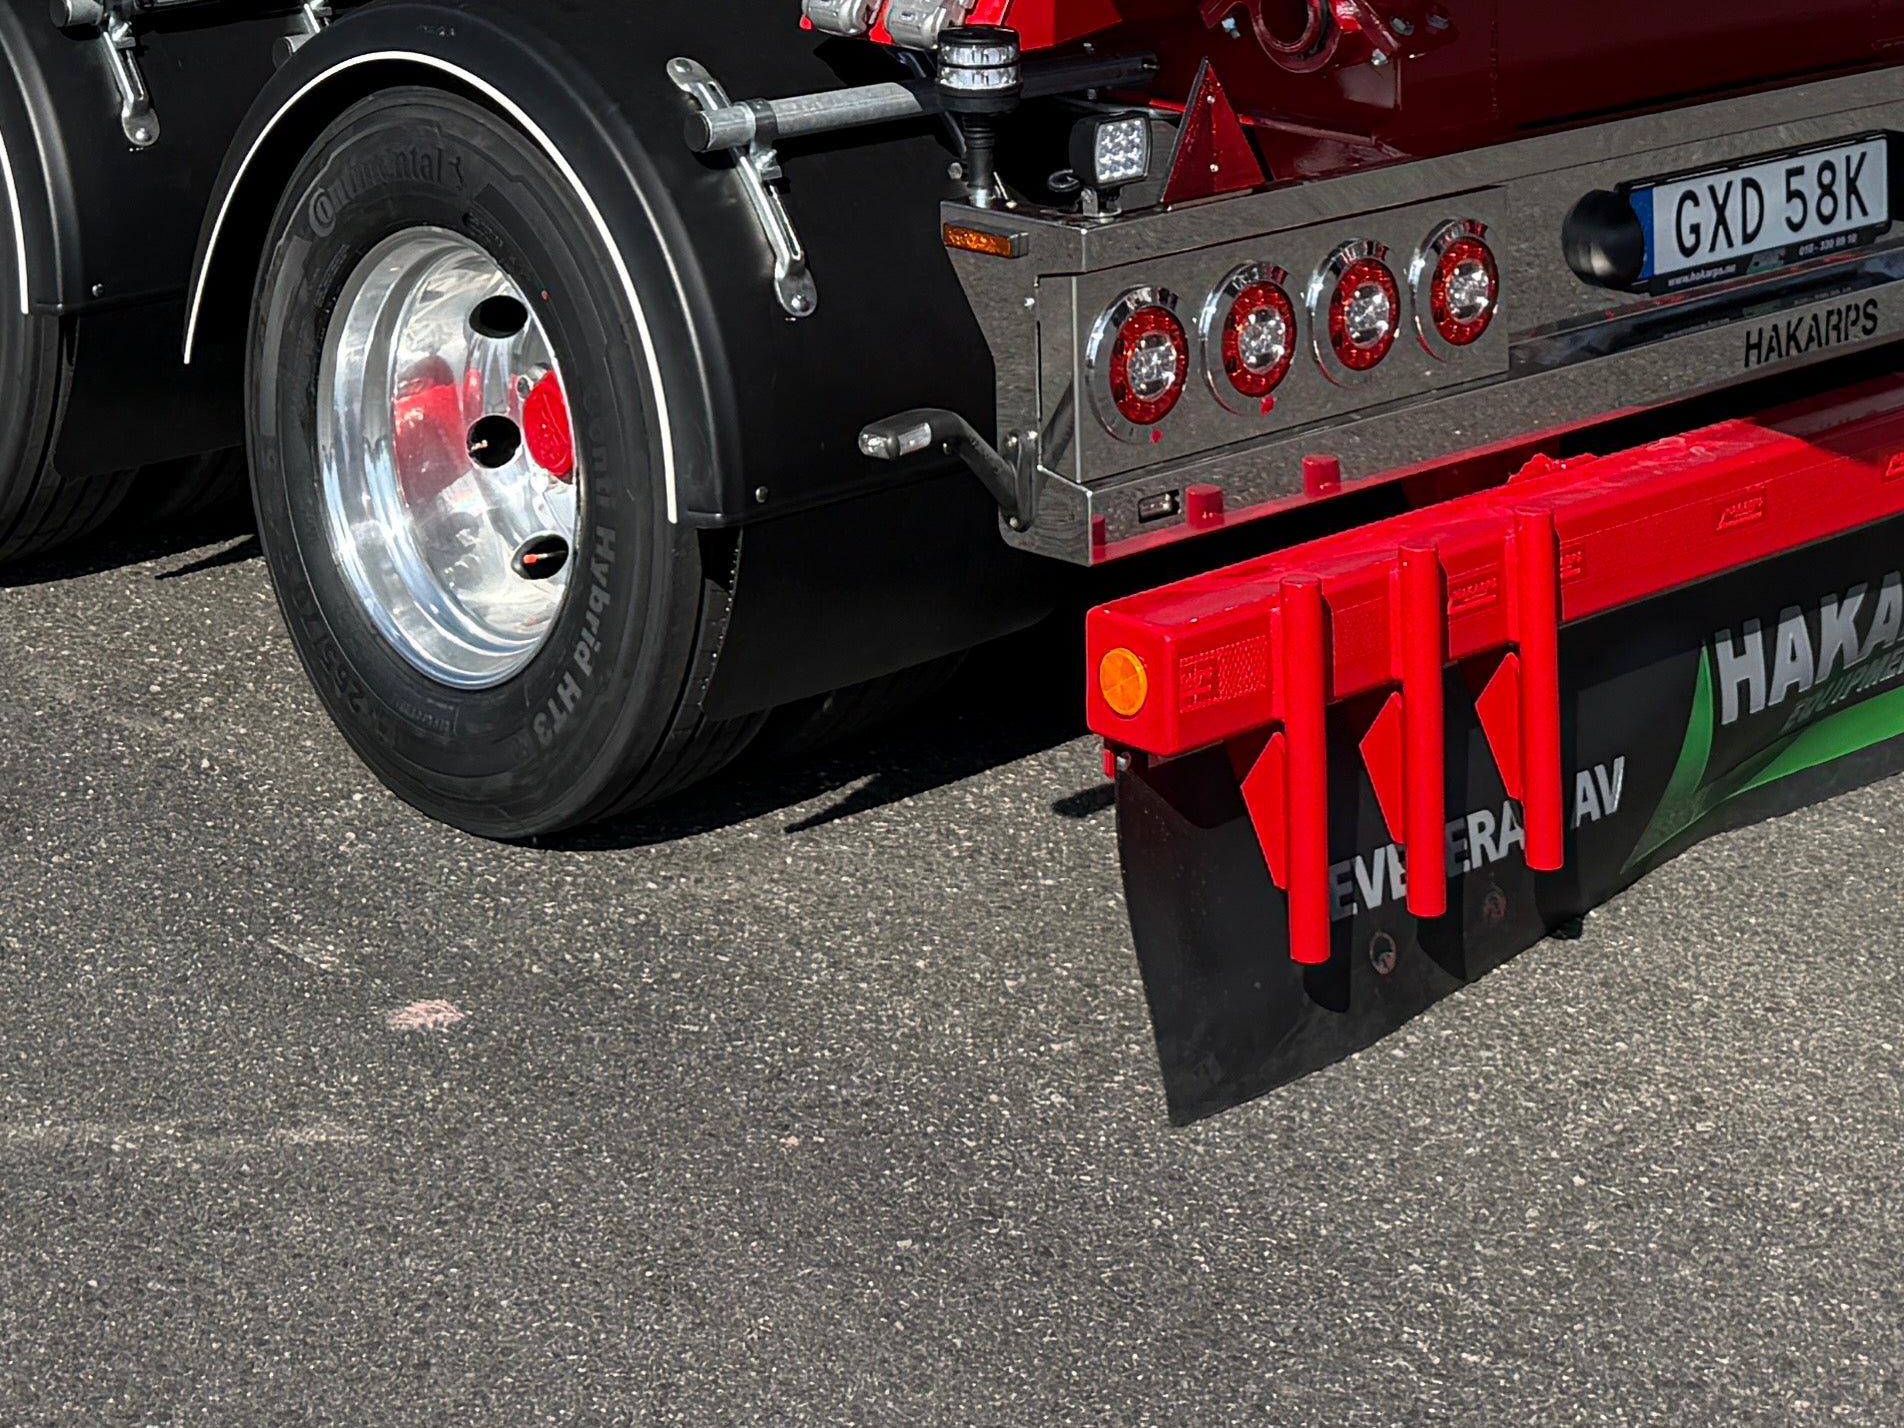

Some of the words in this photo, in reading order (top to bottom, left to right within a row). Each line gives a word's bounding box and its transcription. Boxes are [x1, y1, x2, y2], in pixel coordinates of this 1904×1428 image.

[1675, 177, 1765, 258] GXD
[1785, 151, 1869, 233] 58K
[1744, 298, 1878, 368] HAKARPS
[573, 525, 616, 677] Hybrid
[533, 671, 583, 744] HT3
[1573, 755, 1626, 830] AV
